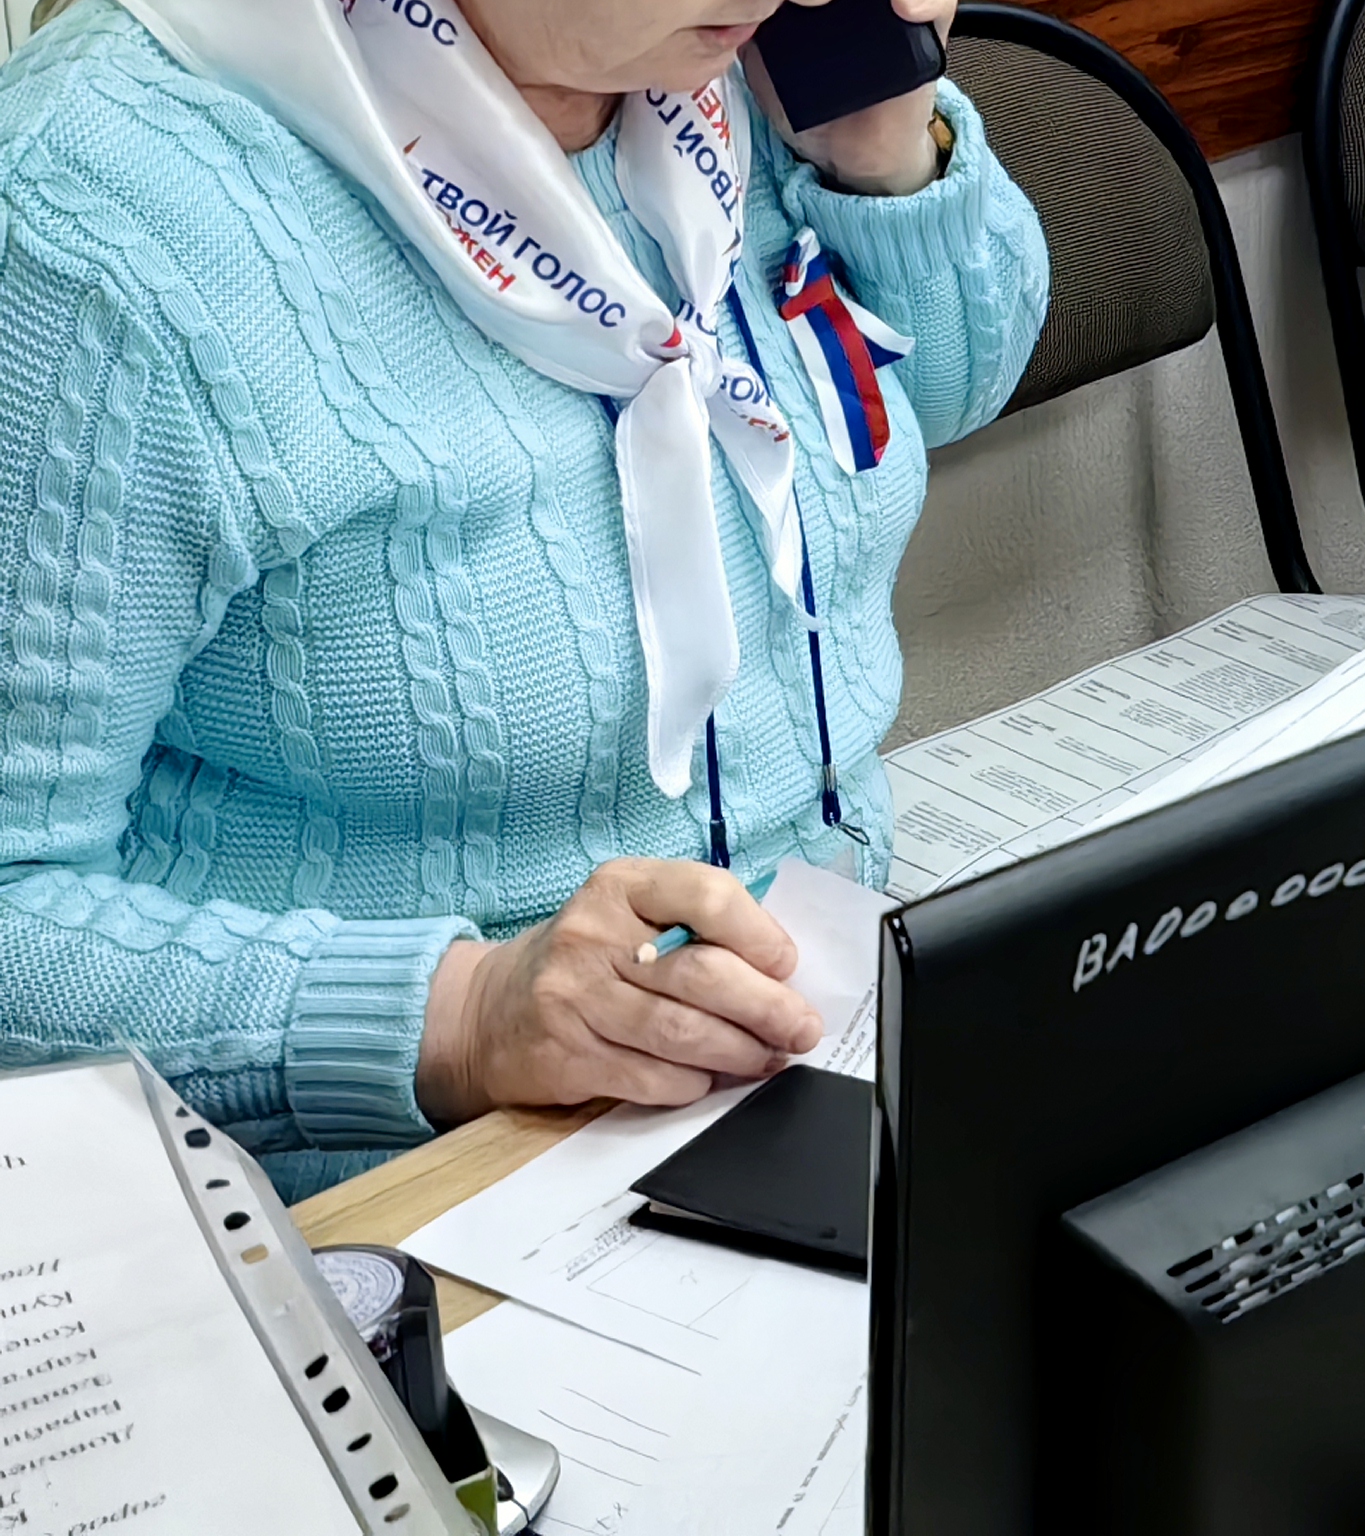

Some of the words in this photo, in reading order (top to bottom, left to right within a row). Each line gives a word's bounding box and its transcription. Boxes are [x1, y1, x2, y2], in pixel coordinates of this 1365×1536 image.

[673, 119, 740, 222] ТВОЙ
[420, 167, 518, 247] ТВОЙ
[512, 235, 627, 328] ГОЛОС
